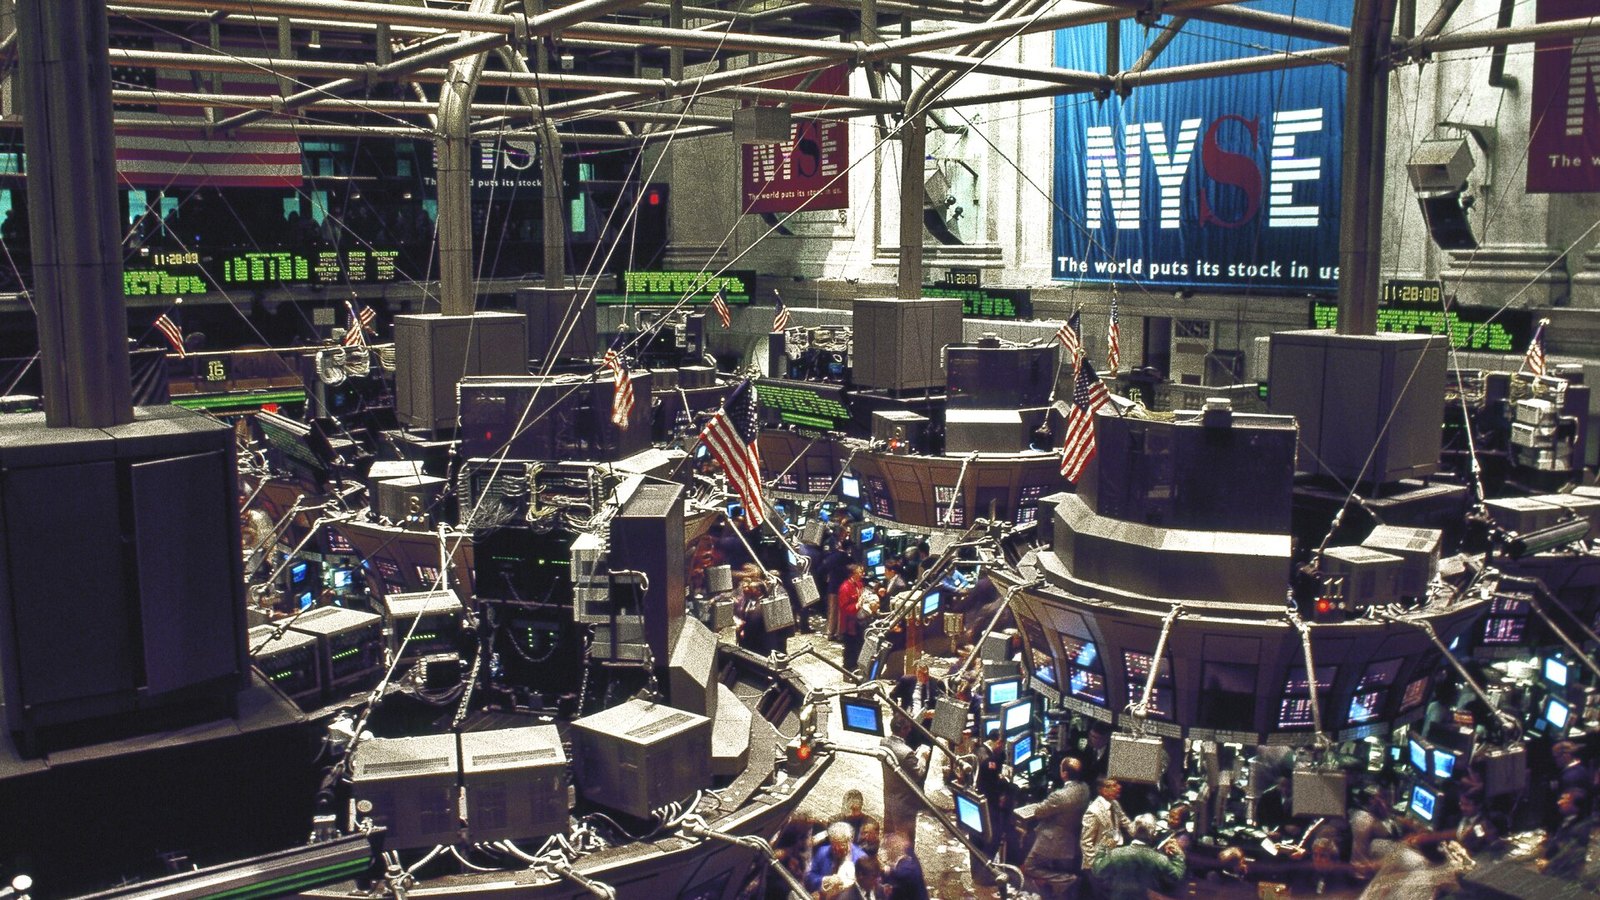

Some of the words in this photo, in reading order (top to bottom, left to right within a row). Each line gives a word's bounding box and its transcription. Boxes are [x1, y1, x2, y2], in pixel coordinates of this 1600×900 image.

[1548, 154, 1581, 168] The
[1086, 108, 1323, 229] NYSE
[478, 180, 498, 188] puts
[502, 178, 514, 187] its
[518, 179, 542, 187] stock
[761, 191, 779, 199] world
[781, 191, 795, 200] puts
[1057, 256, 1088, 273] The
[1095, 258, 1142, 275] world
[1149, 261, 1188, 280] puts
[1196, 259, 1219, 276] its
[1228, 260, 1281, 277] stock
[1290, 260, 1309, 278] in
[208, 364, 224, 376] 16
